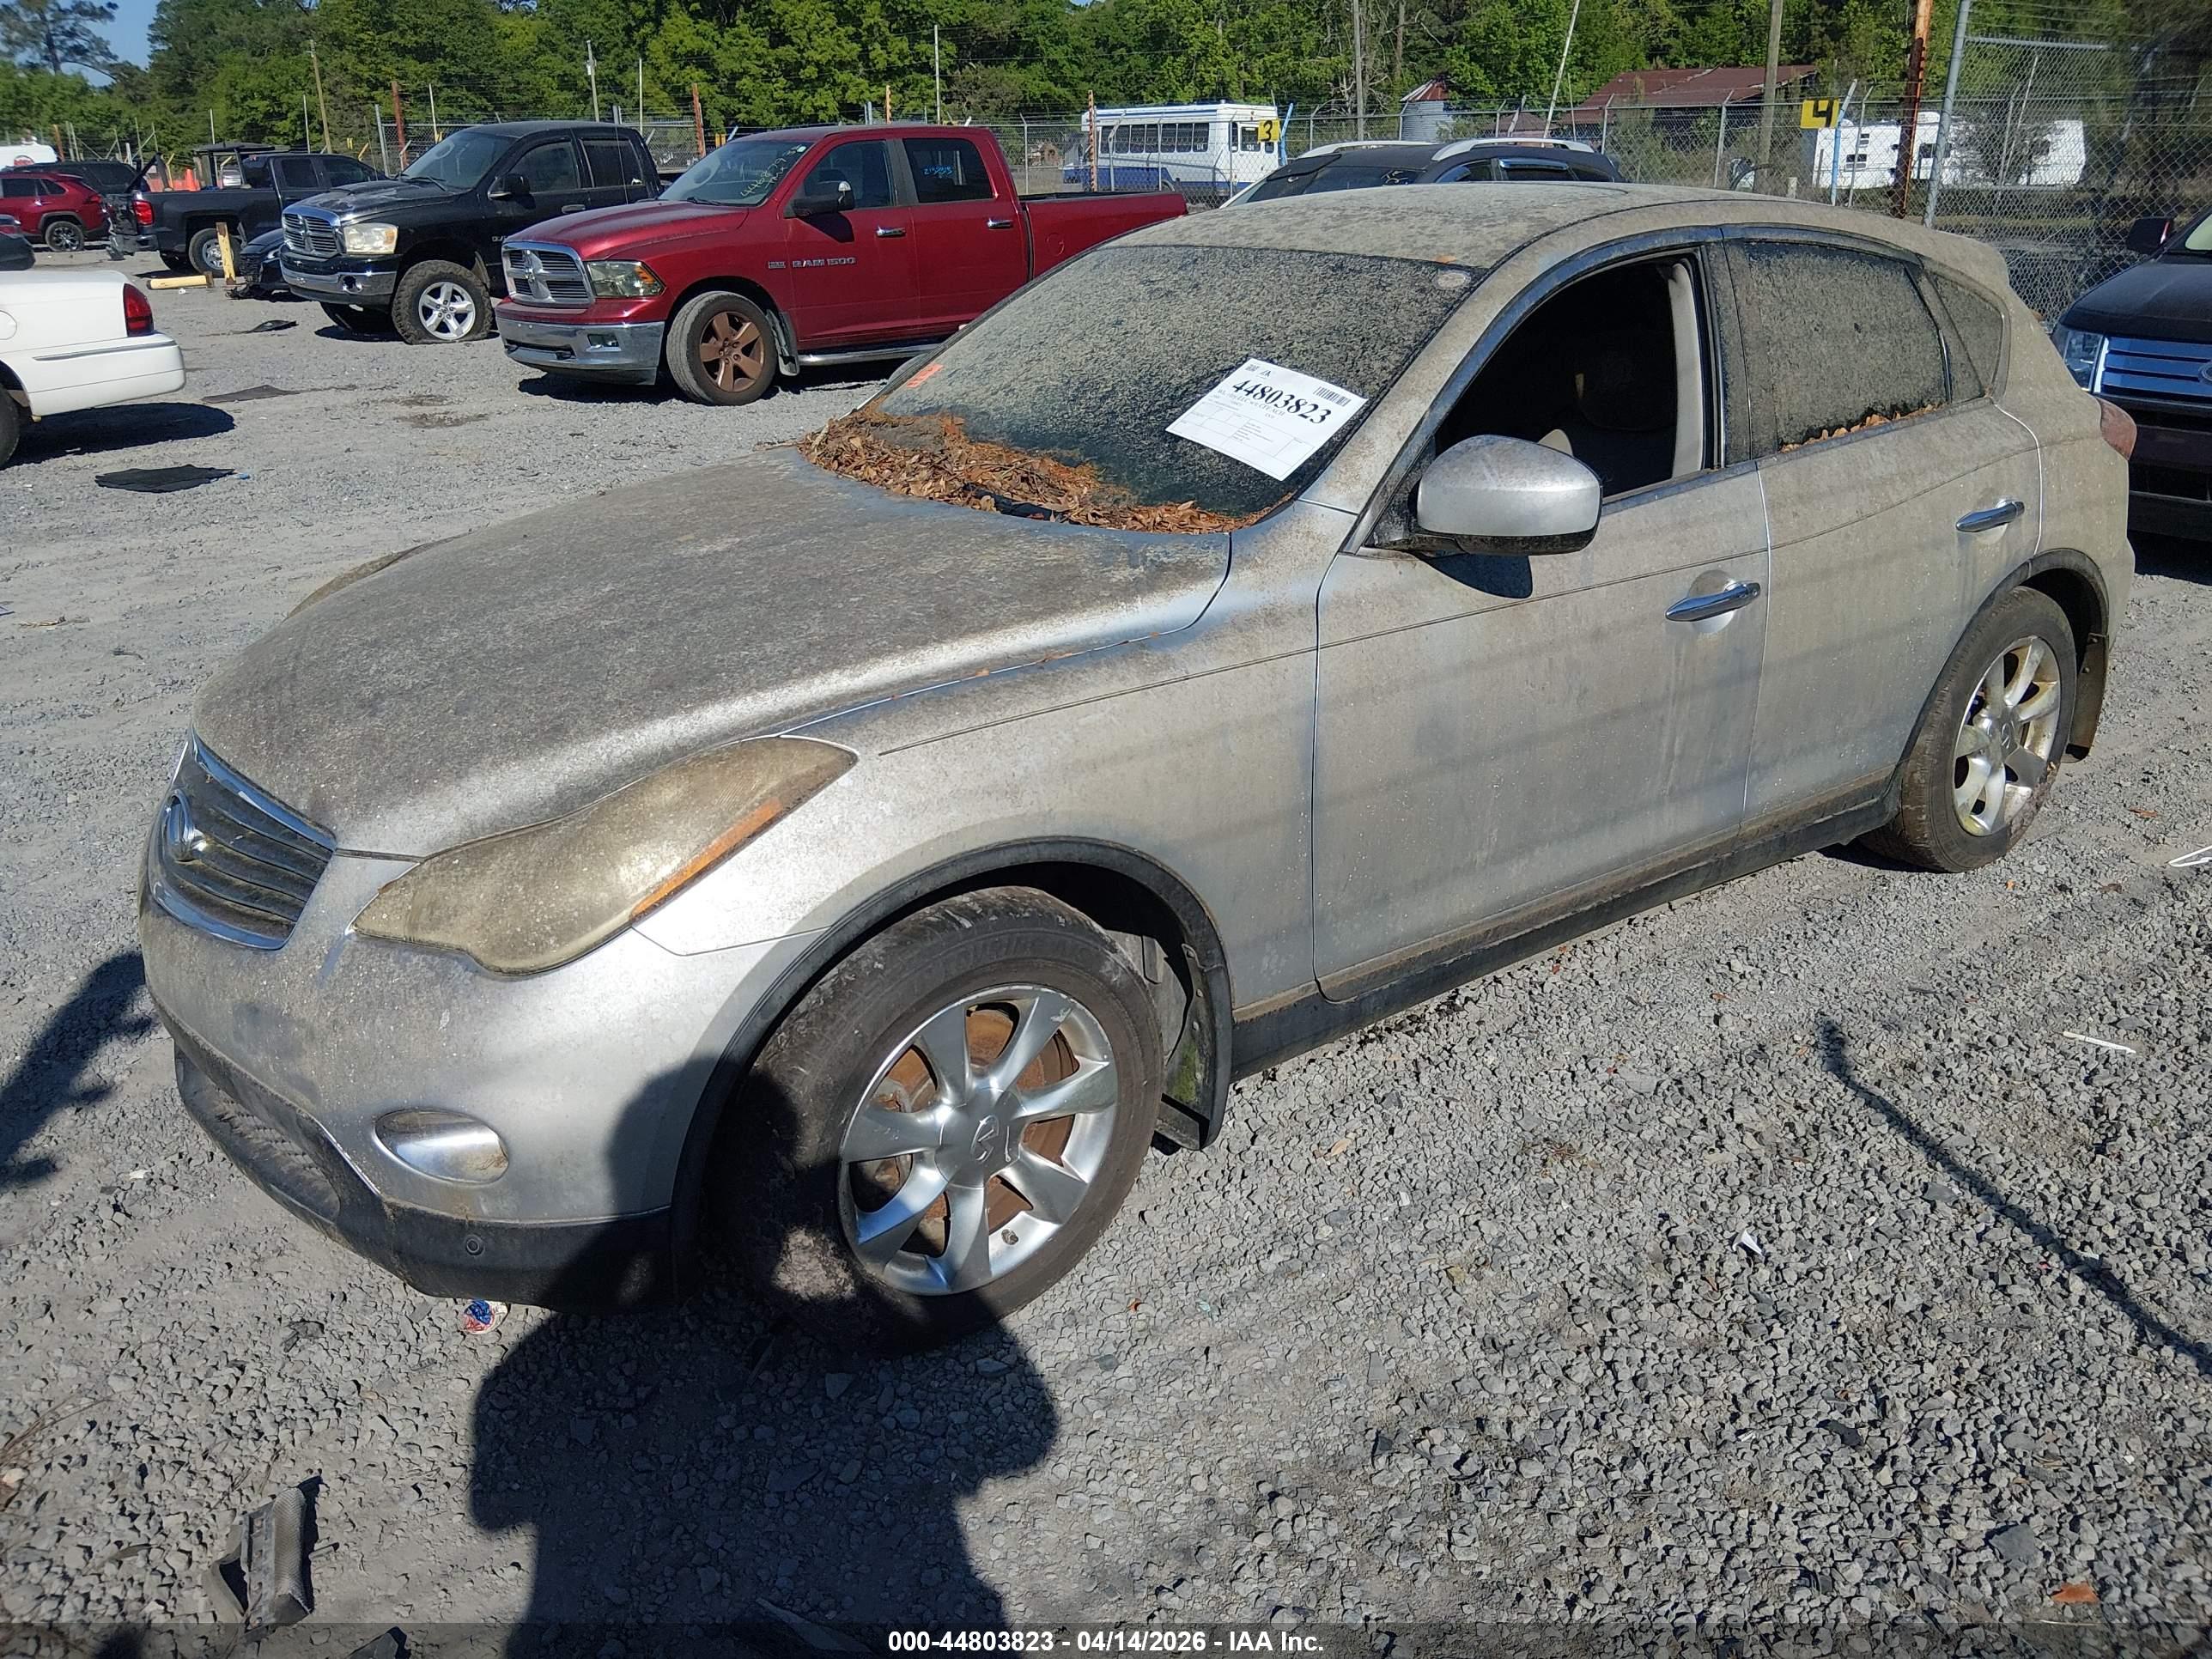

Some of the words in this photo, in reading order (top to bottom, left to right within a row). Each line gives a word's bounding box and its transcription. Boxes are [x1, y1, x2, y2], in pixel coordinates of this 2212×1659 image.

[1813, 96, 1835, 127] 4
[1261, 119, 1273, 142] 3
[793, 258, 825, 268] RAM
[827, 257, 856, 266] 1500
[1232, 380, 1332, 424] 44803823
